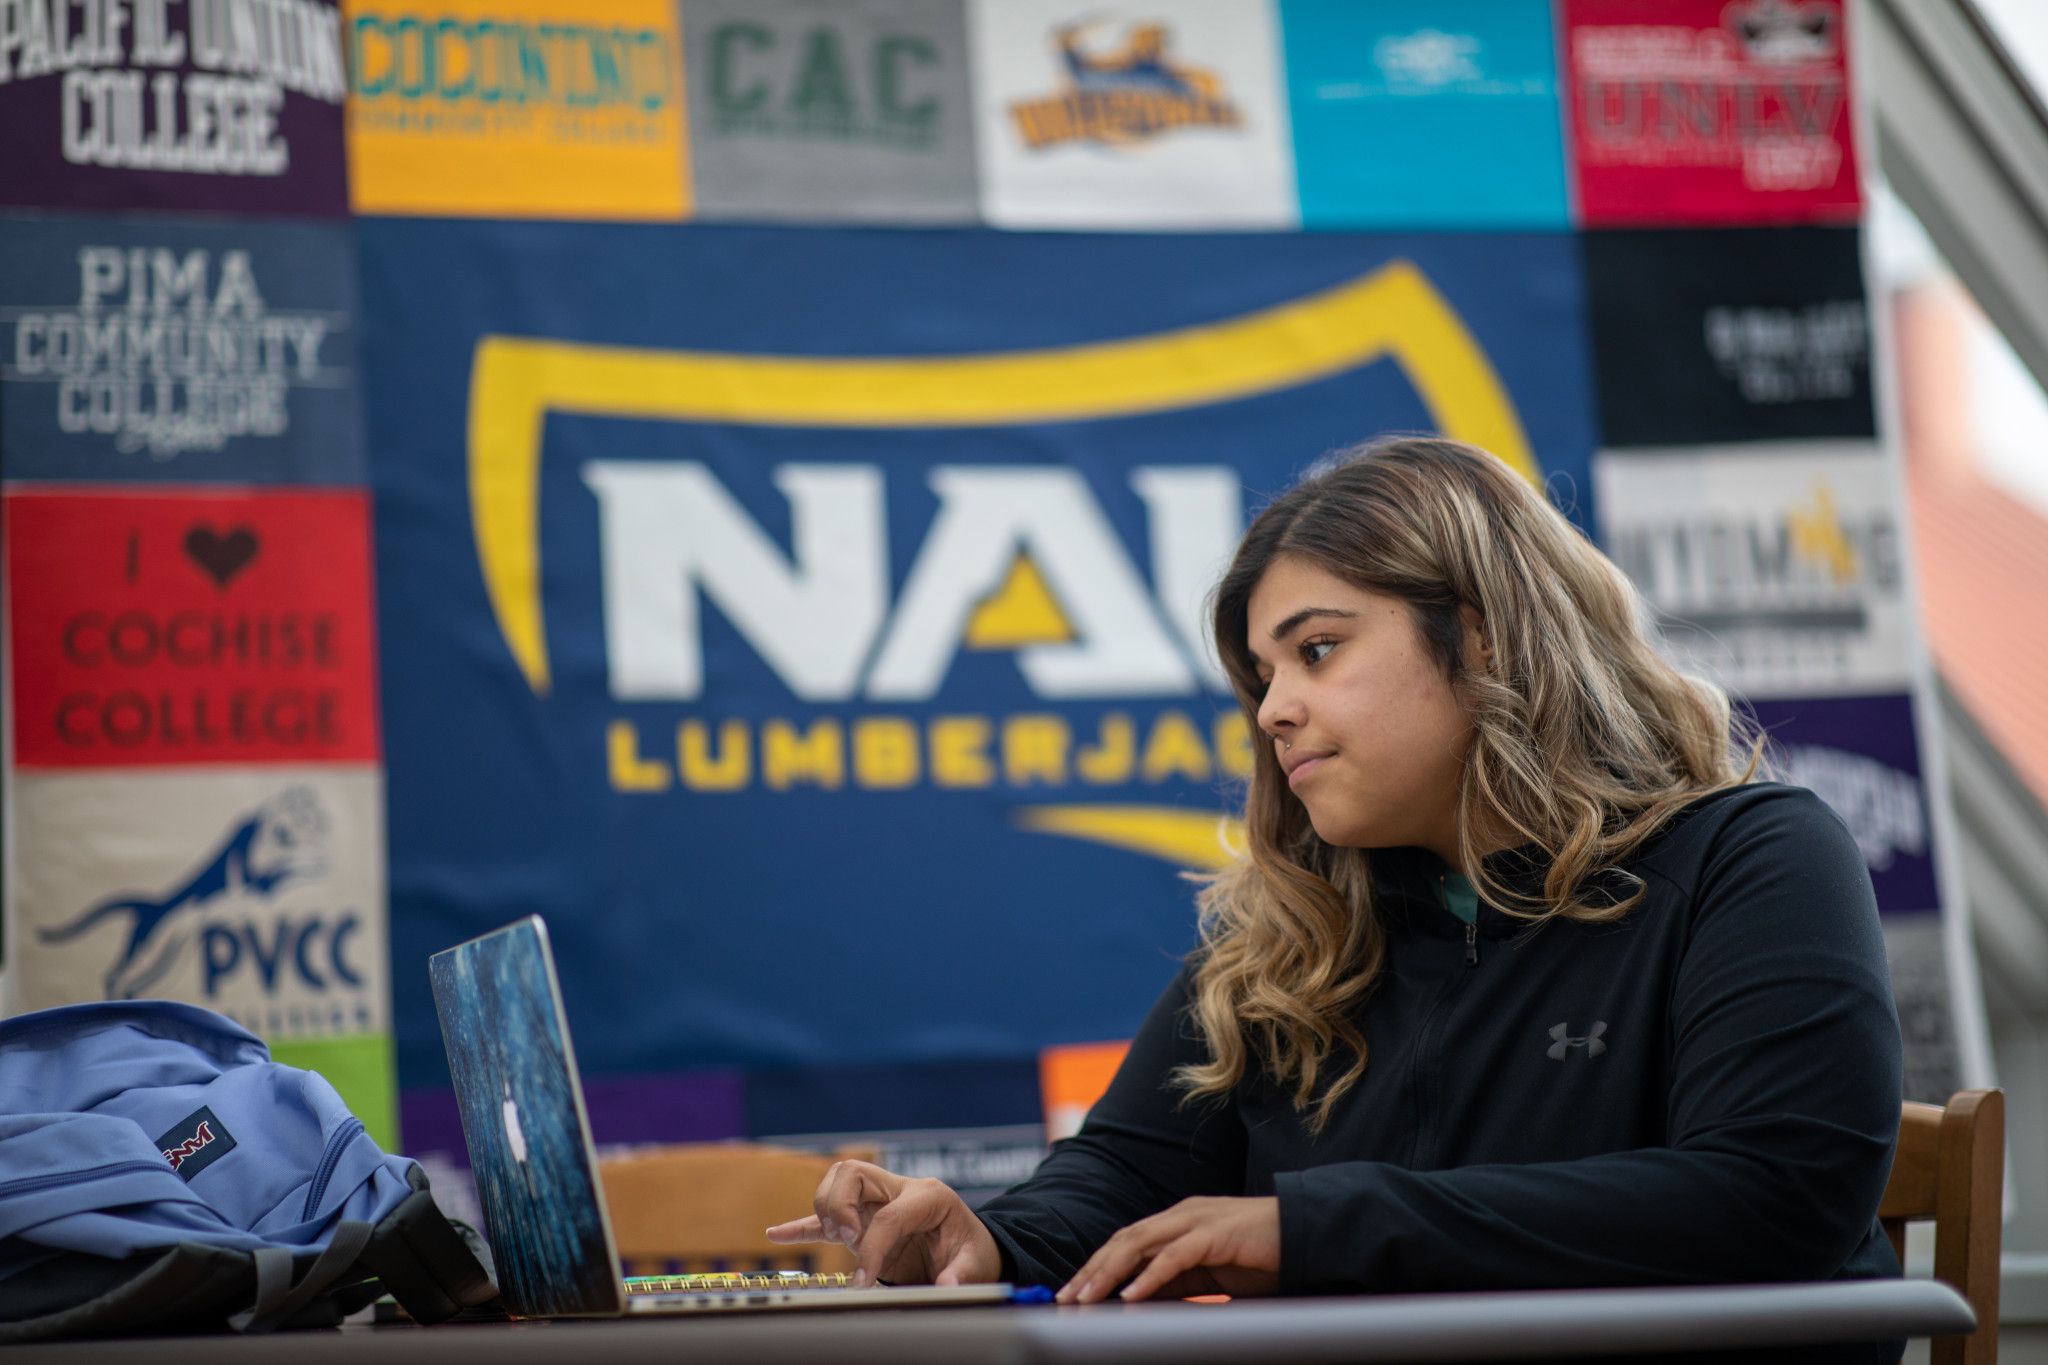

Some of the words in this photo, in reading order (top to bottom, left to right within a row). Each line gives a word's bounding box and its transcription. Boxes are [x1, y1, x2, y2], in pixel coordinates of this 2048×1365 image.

[0, 0, 187, 84] PACIFIC
[188, 0, 348, 104] UNION
[353, 16, 670, 115] COCONINO
[705, 20, 943, 126] CAC
[61, 68, 290, 175] COLLEGE
[1584, 78, 1843, 143] UNLV
[79, 245, 264, 318] PIMA
[16, 312, 326, 380] COMMUNITY
[58, 374, 290, 437] COLLEGE
[126, 527, 142, 586] I
[61, 609, 340, 670] COCHISE
[55, 690, 343, 748] COLLEGE
[203, 910, 366, 1000] PVCC
